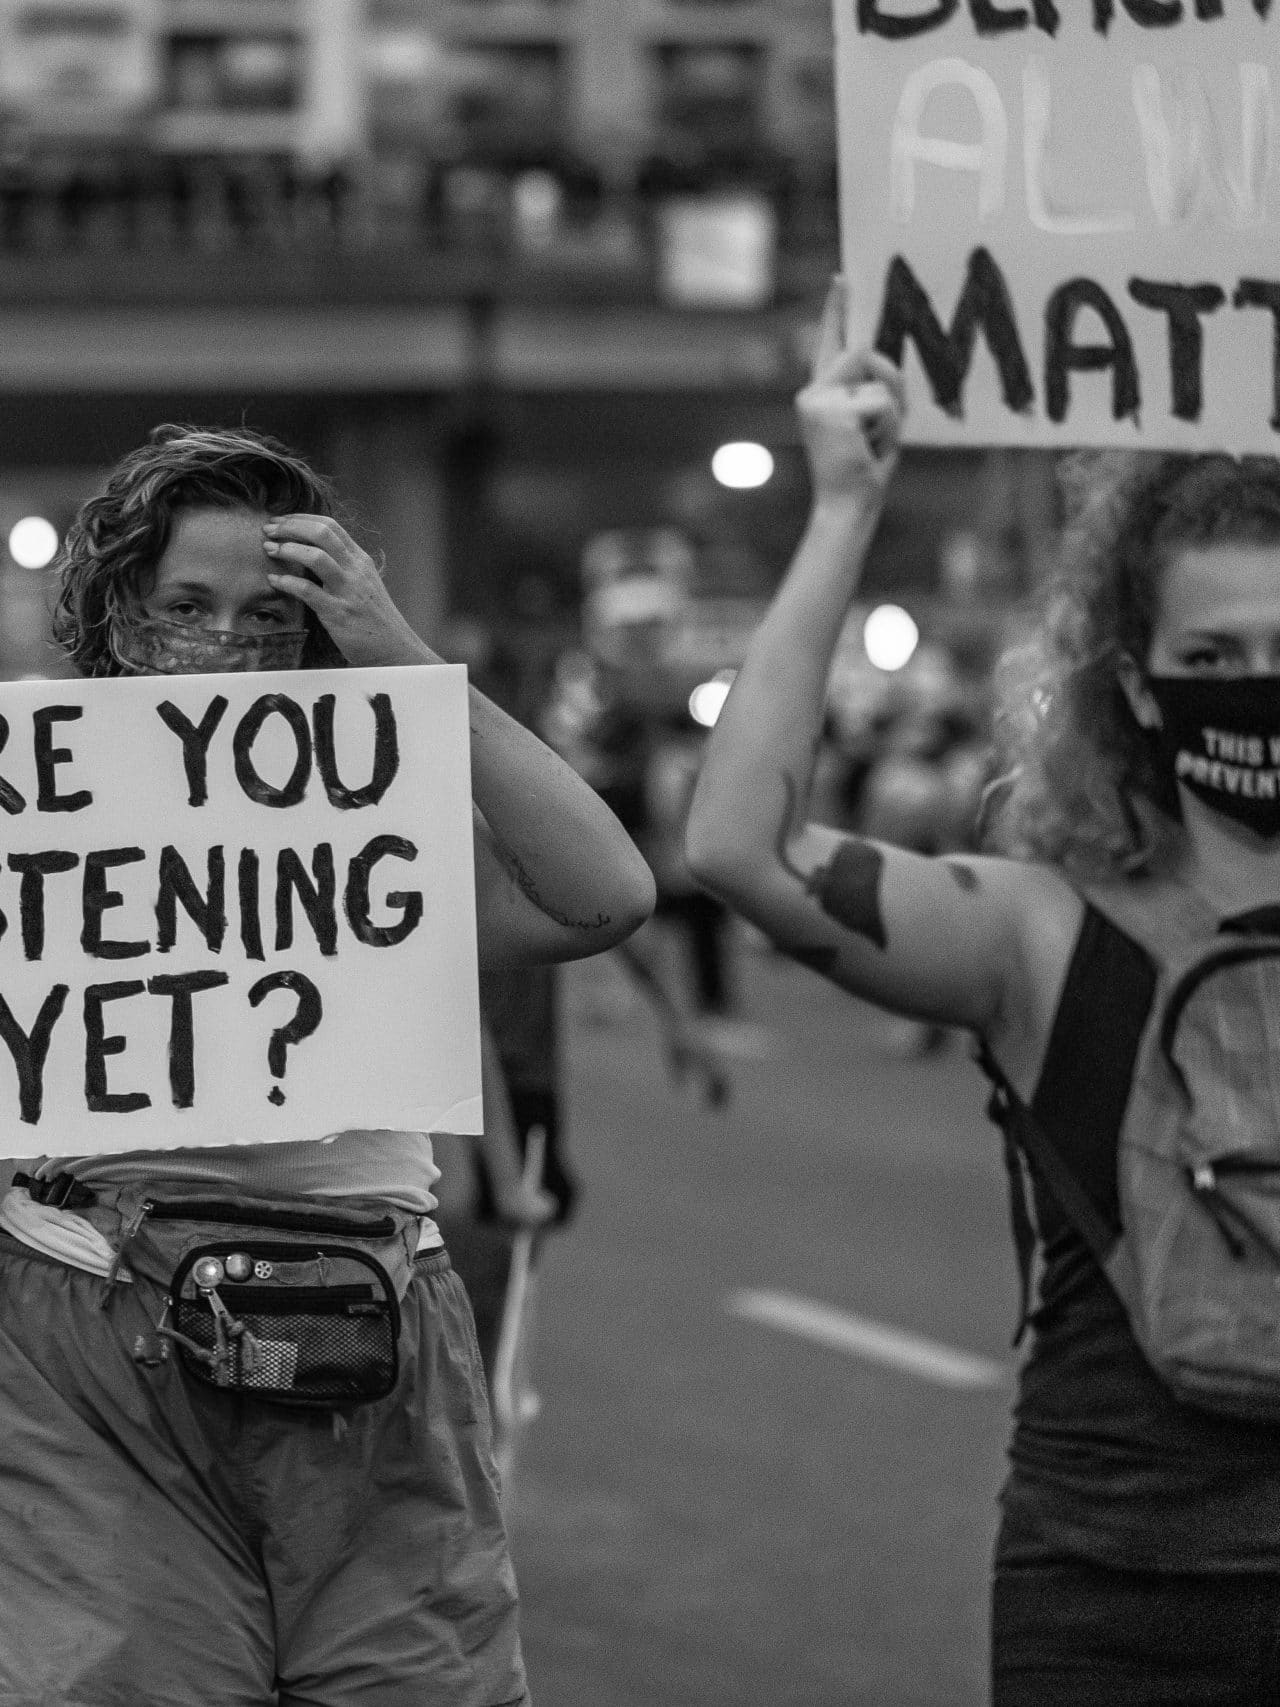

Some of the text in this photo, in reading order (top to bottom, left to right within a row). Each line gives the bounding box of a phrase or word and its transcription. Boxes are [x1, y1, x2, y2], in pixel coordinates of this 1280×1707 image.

[156, 693, 400, 811] YOU
[1202, 727, 1263, 766] THIS
[1175, 750, 1280, 798] PREVEN
